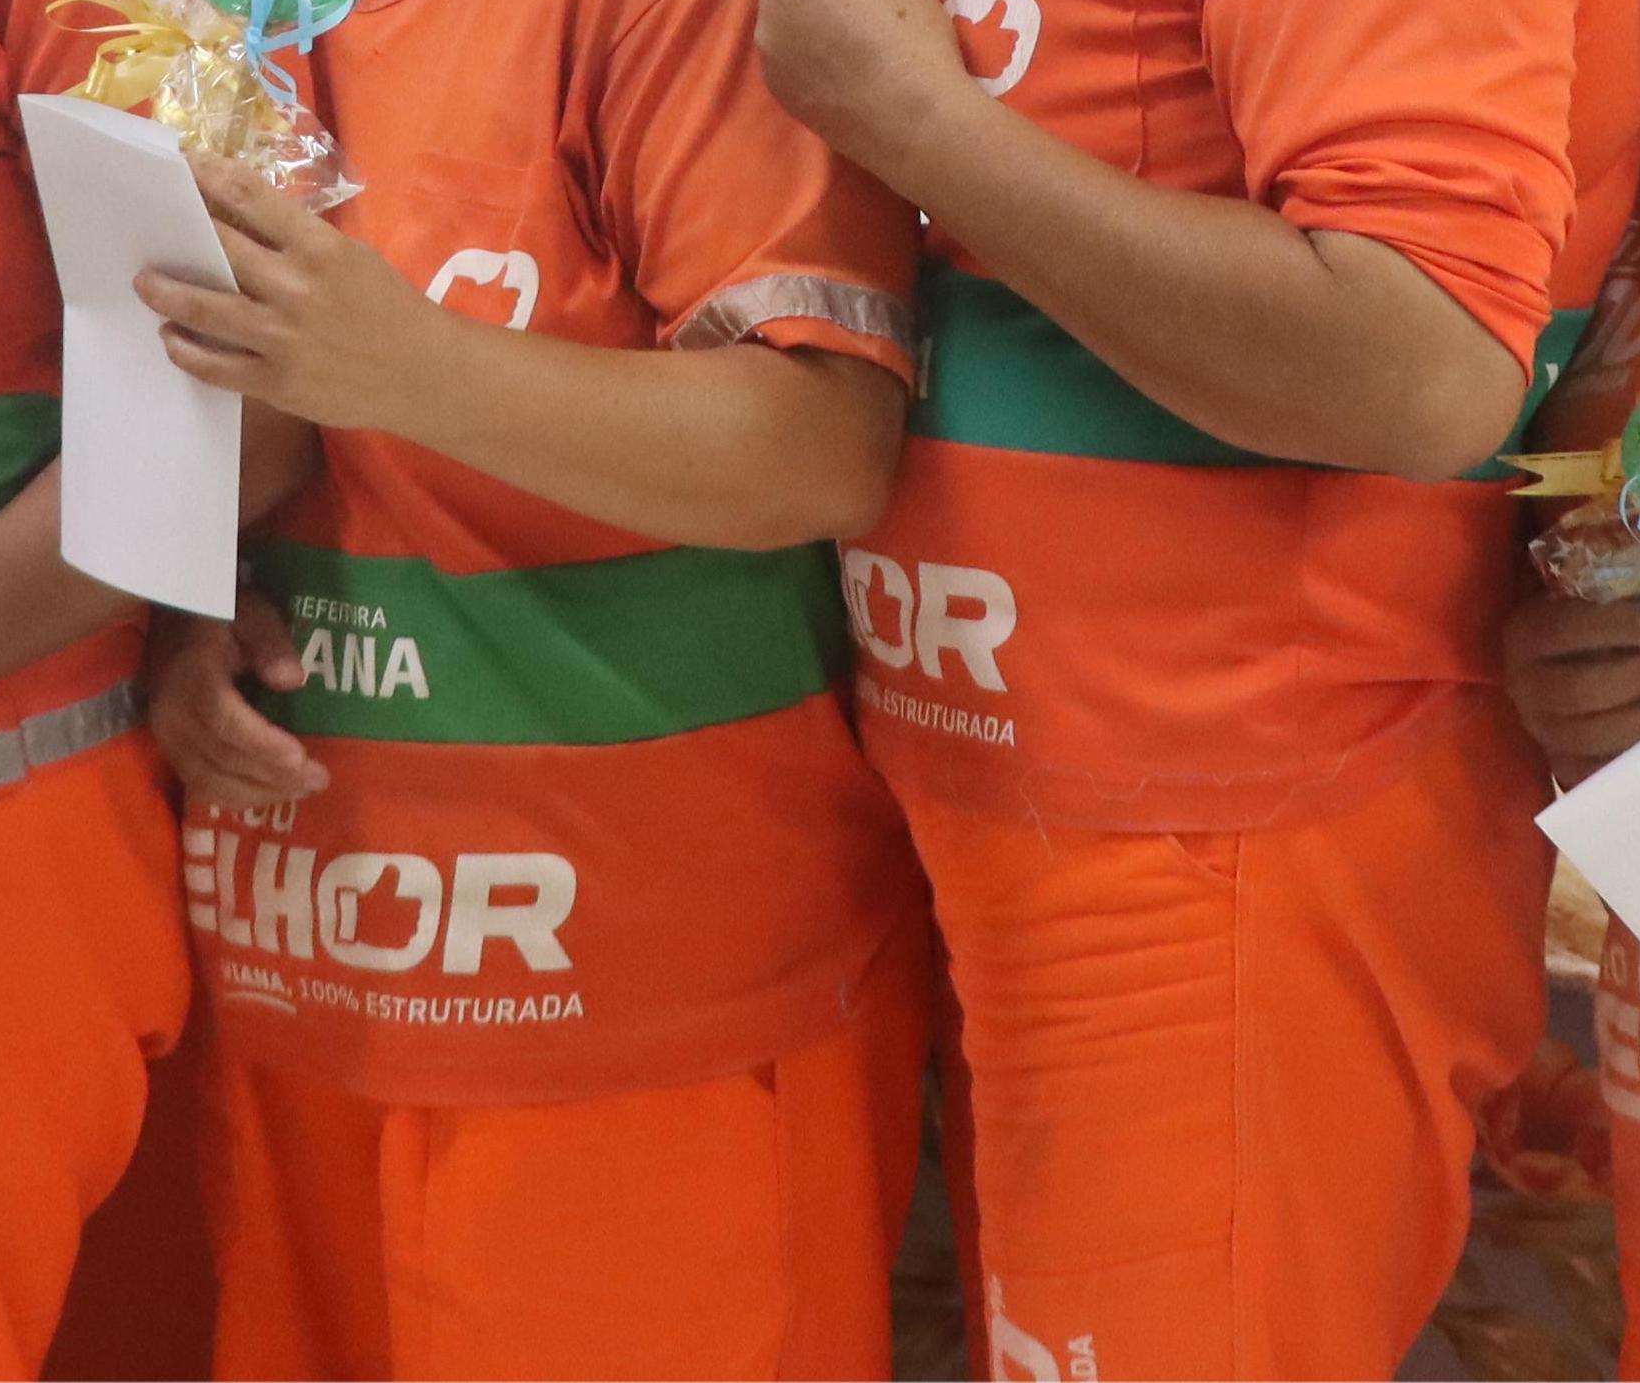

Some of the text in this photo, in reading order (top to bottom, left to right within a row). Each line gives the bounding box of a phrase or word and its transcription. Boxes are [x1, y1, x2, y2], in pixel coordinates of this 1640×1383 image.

[883, 688, 1015, 747] ESTRUTURADA
[300, 977, 359, 1011] 100%
[366, 991, 584, 1025] ESTRUTURADA
